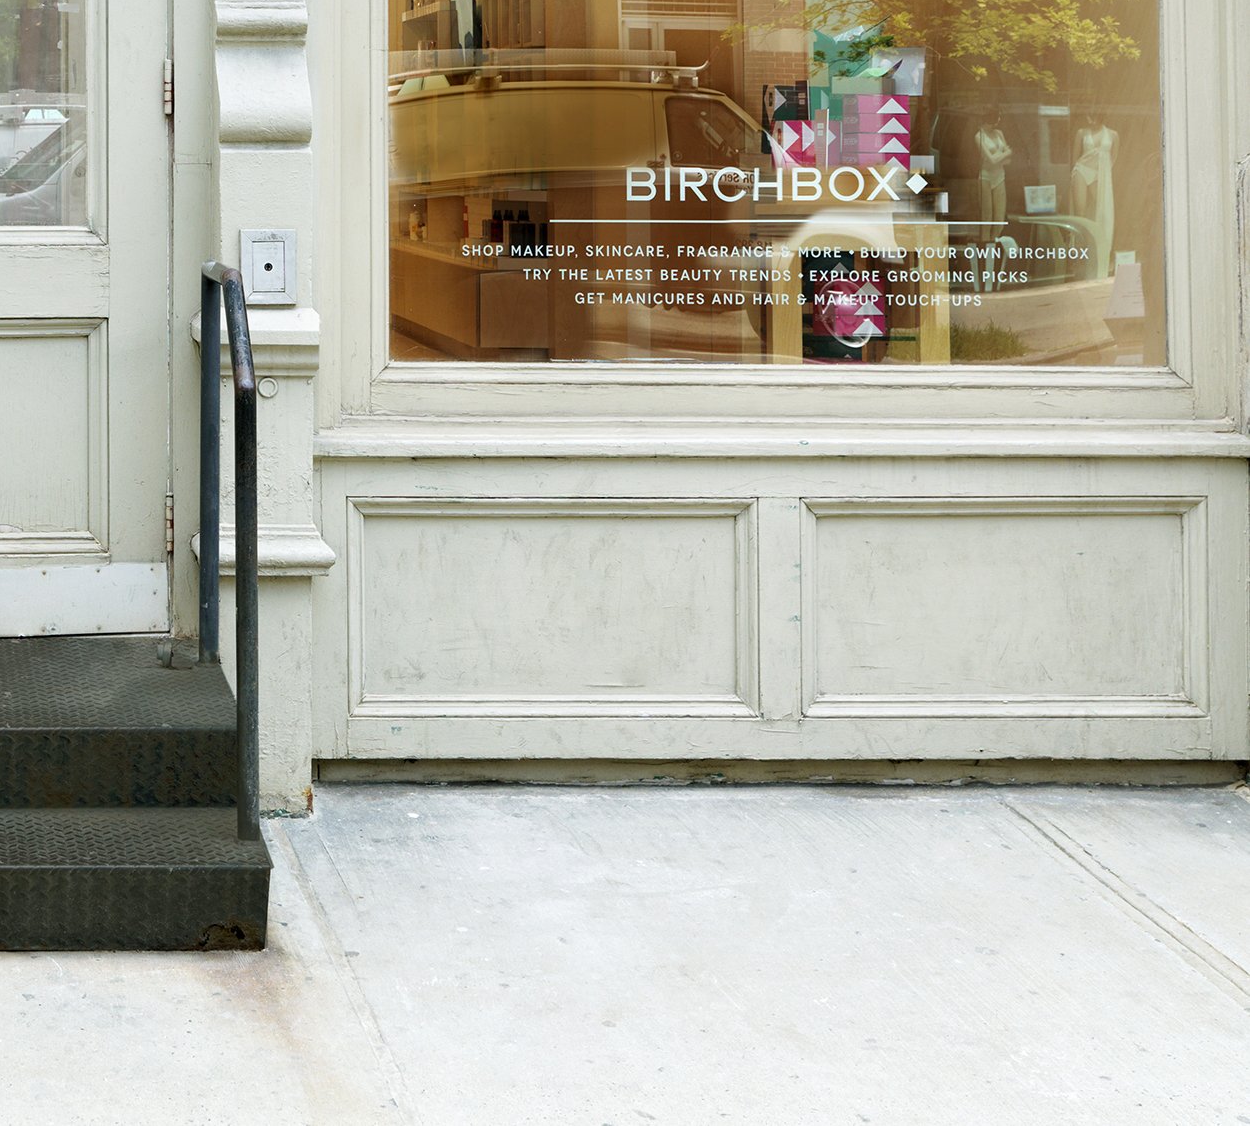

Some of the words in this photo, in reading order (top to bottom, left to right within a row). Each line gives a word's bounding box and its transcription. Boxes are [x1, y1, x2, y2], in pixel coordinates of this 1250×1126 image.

[626, 166, 901, 203] BIRCHBOX
[461, 244, 504, 258] SHOP
[510, 244, 578, 259] MAKEUP,
[585, 245, 670, 259] SKINCARE,
[677, 245, 774, 259] FRAGRANCE
[797, 246, 842, 259] MORE
[859, 247, 908, 260] BUILD
[914, 247, 958, 260] YOUR
[963, 247, 1002, 260] OWN
[1008, 247, 1090, 261] BIRCHBOX
[522, 268, 552, 281] TRY
[558, 268, 589, 281] THE
[595, 268, 654, 282] LATEST
[660, 269, 722, 282] BEAUTY
[729, 269, 792, 282] TRENDS
[808, 269, 881, 283] EXPLORE
[887, 270, 976, 283] GROOMING
[981, 270, 1029, 283] PICKS
[574, 292, 606, 305] GET
[611, 292, 705, 305] MANICURES
[711, 292, 746, 305] AND
[752, 293, 791, 306] HAIR
[796, 293, 808, 306] &
[813, 293, 880, 307] MAKEUP
[885, 294, 983, 307] TOUCH-UPS
